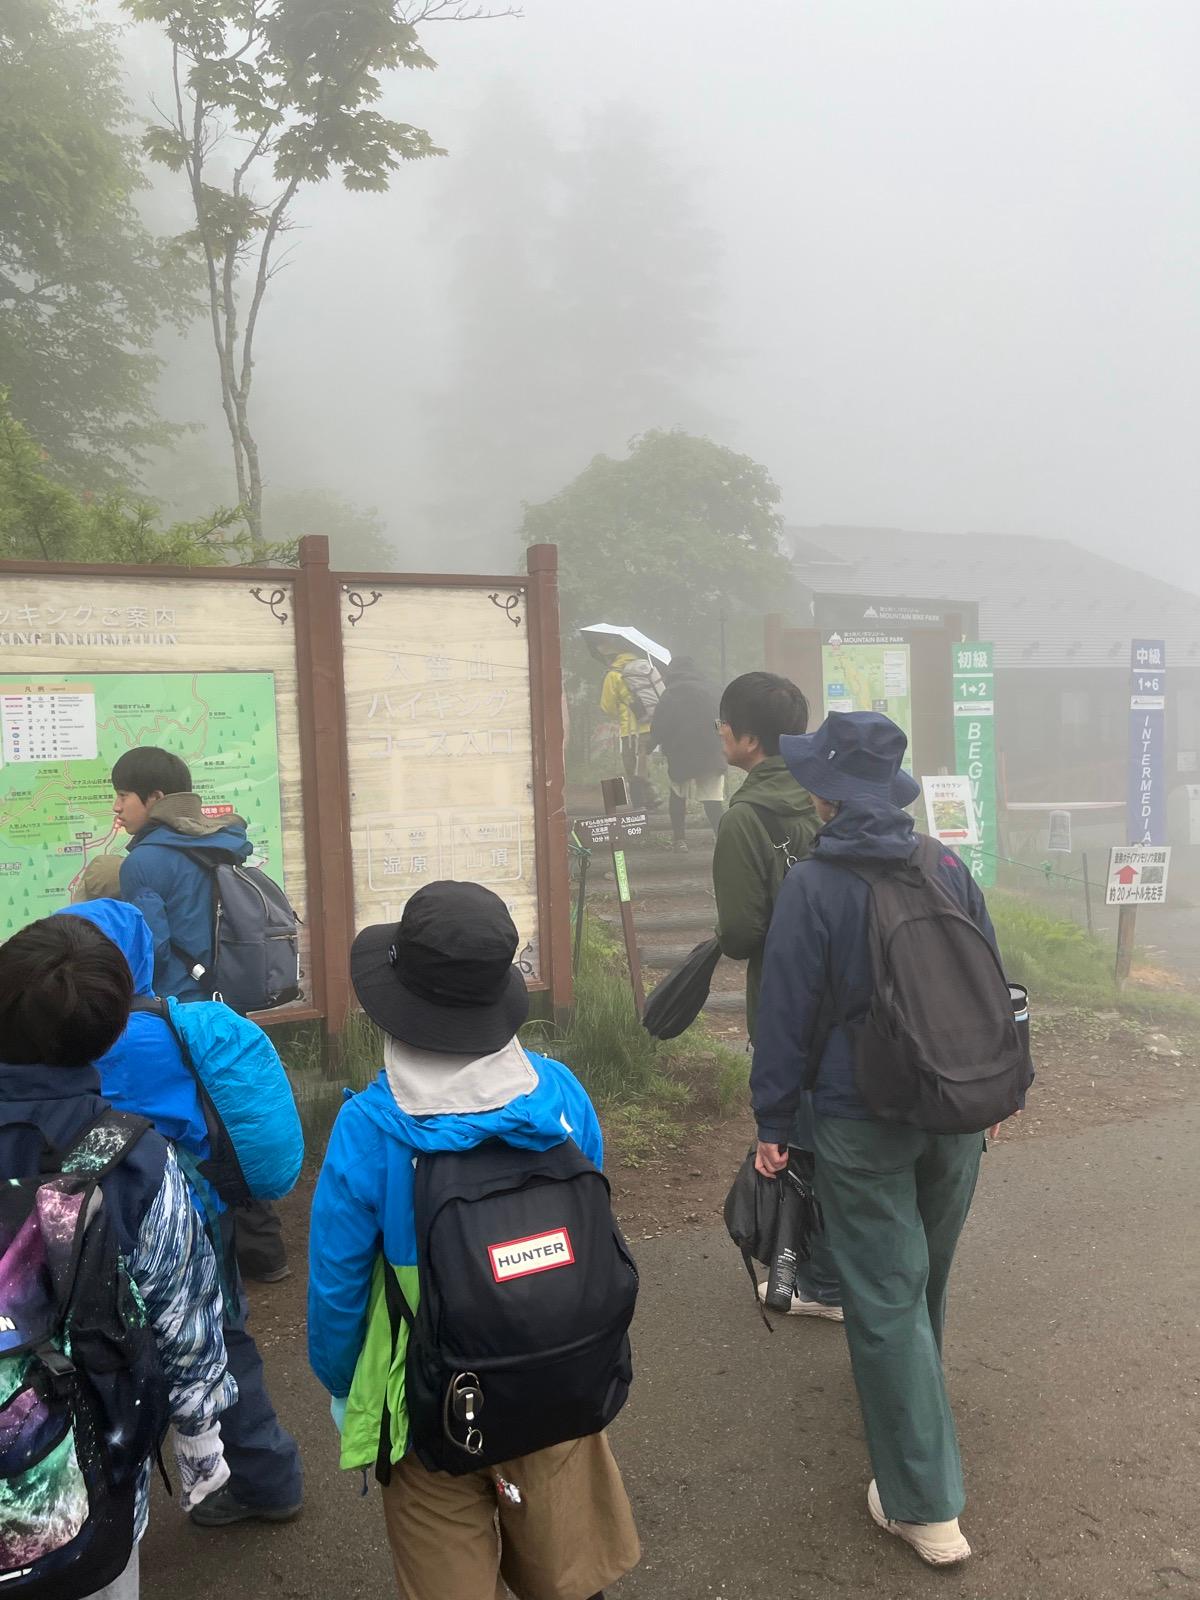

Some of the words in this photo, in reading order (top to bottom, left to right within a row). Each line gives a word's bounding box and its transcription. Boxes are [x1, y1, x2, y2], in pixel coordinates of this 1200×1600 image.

[879, 612, 912, 620] MOUNTAIN
[958, 651, 988, 669] 初級
[1136, 648, 1161, 664] 中級
[367, 688, 512, 720] ハイキング
[368, 728, 512, 758] コース入口
[1140, 715, 1152, 846] INTERMEDIA
[383, 855, 428, 874] 湿原
[466, 848, 510, 869] 山頂
[498, 1242, 565, 1268] HUNTER
